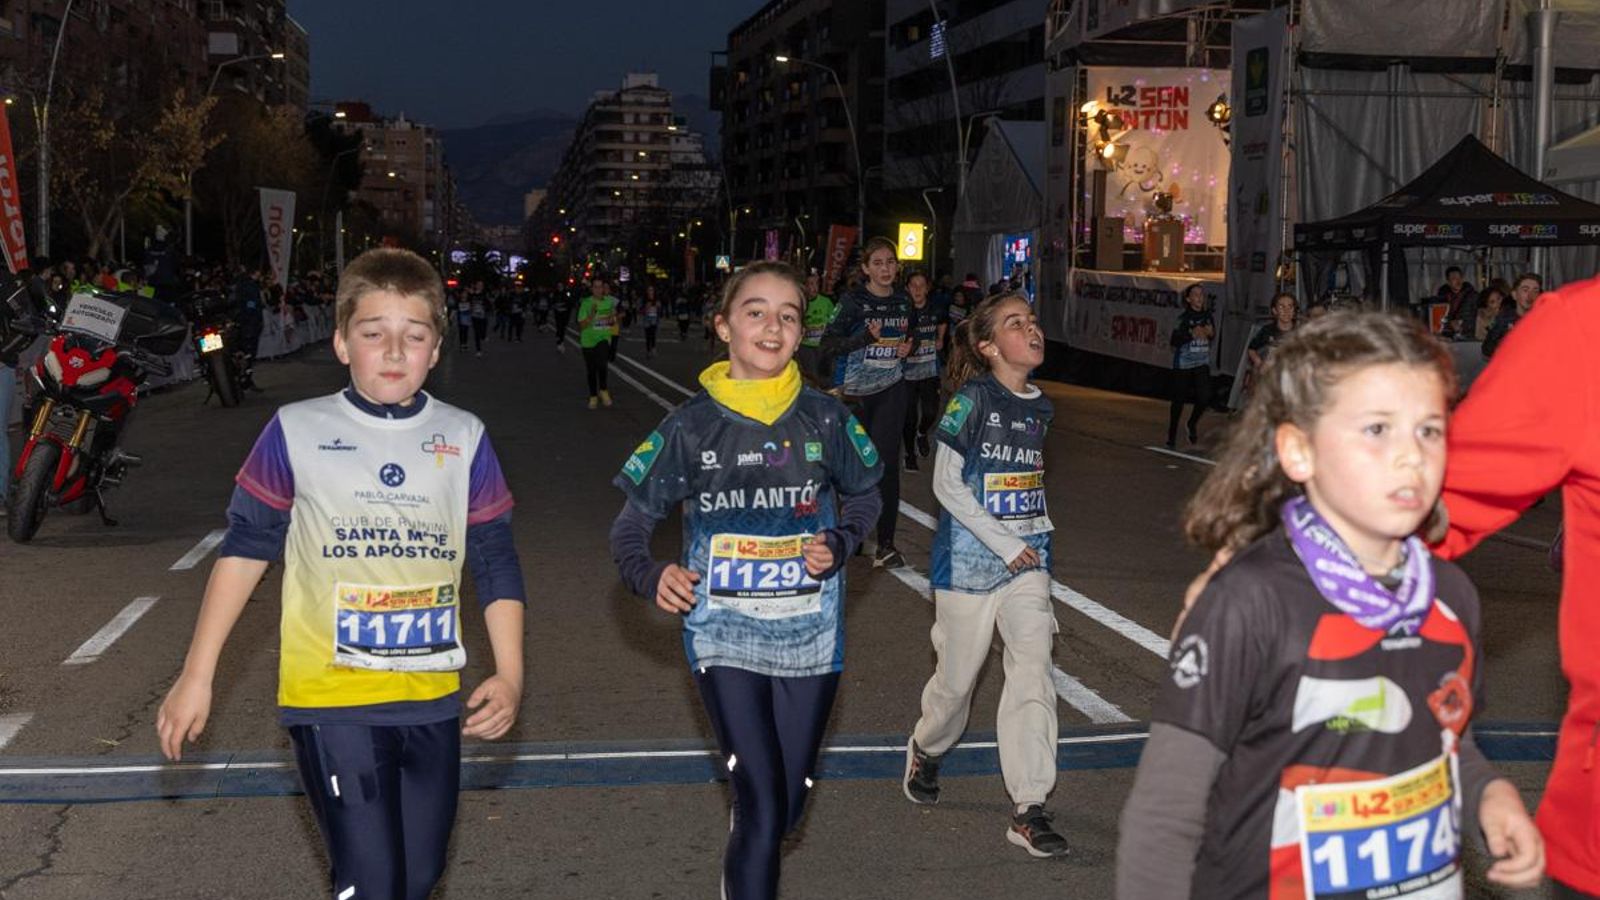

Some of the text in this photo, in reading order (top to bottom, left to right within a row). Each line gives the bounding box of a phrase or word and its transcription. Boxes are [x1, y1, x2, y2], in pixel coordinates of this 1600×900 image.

[1107, 85, 1189, 107] 42 SAN
[1107, 109, 1189, 130] NTON
[1393, 223, 1464, 237] superscreen
[1488, 223, 1558, 237] superscreen
[981, 442, 1012, 461] SAN
[1004, 477, 1018, 488] 42
[354, 490, 385, 499] PABLO
[699, 488, 746, 513] SAN
[988, 490, 1045, 513] 11327
[331, 516, 369, 527] CLUB
[375, 516, 392, 527] DE
[335, 528, 402, 541] SANTA
[322, 543, 458, 561] LOS APÓSTOES
[737, 541, 758, 556] 42
[340, 609, 452, 646] 11711
[1352, 792, 1389, 819] 42
